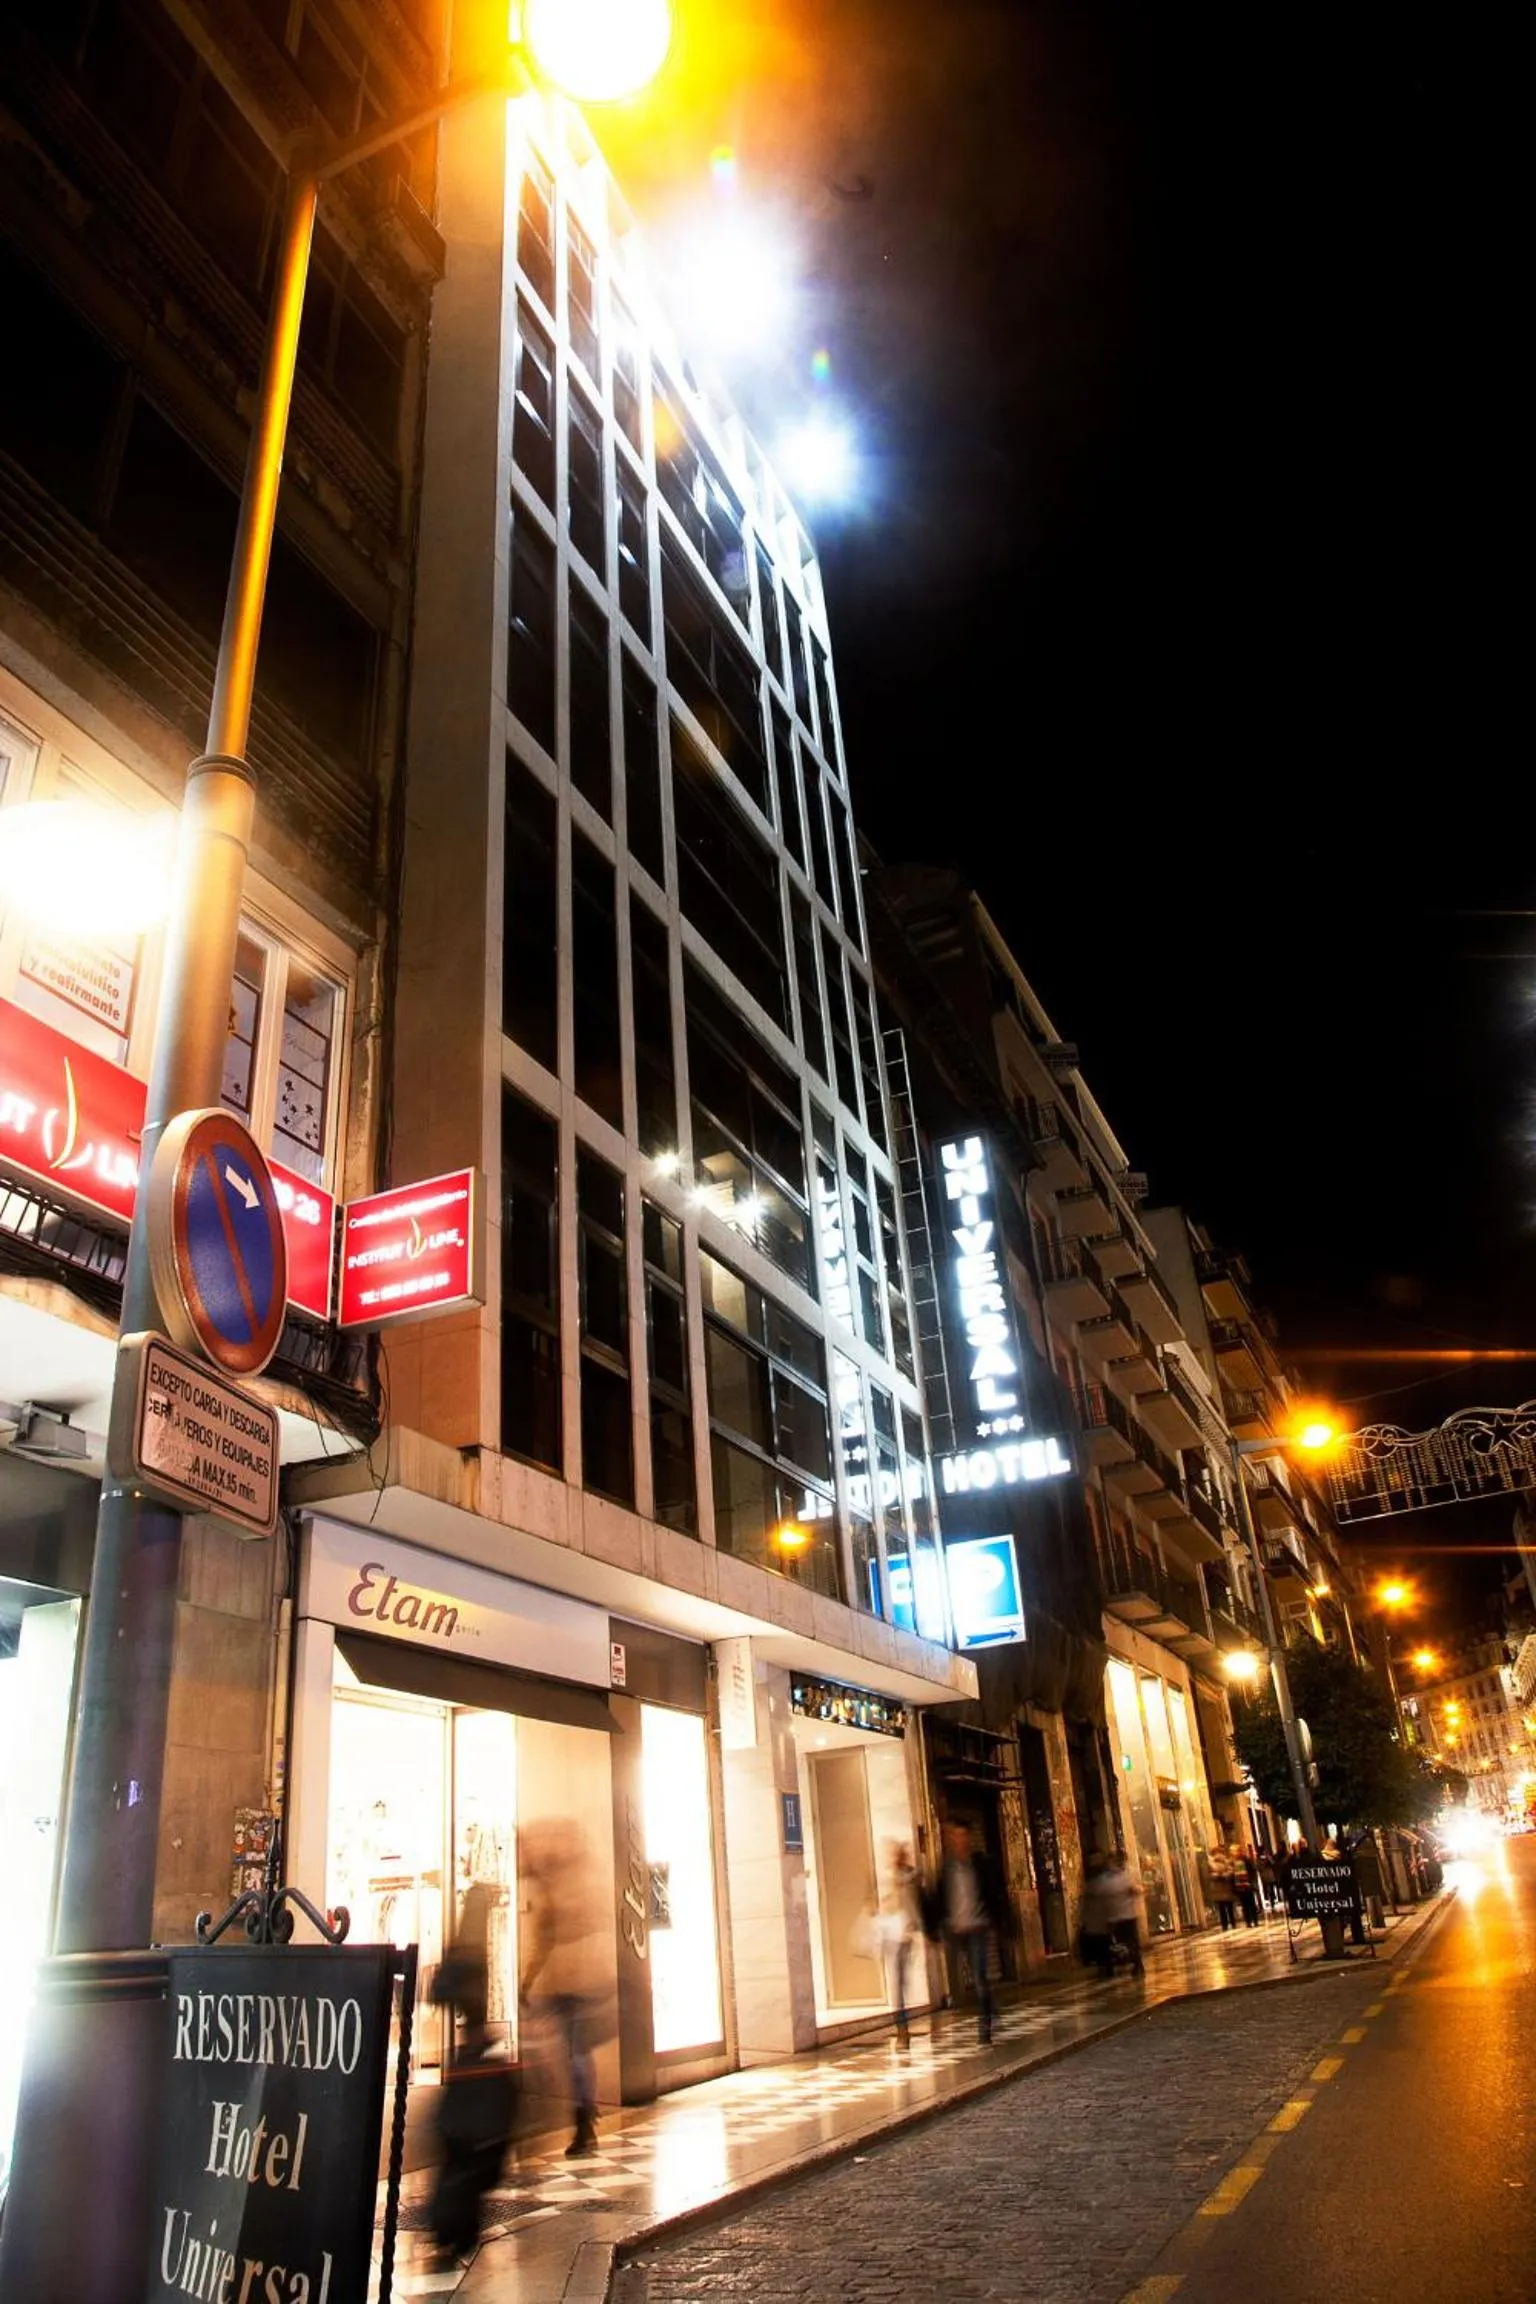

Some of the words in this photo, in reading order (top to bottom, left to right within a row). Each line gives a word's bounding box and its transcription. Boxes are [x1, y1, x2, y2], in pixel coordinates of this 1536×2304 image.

[43, 964, 121, 1021] reafirmante
[940, 1135, 1018, 1412] UNIVERSAL
[150, 1363, 193, 1401] EXCEPTO
[193, 1387, 221, 1421] CARGA
[221, 1406, 229, 1424] Y
[214, 1432, 223, 1451] Y
[222, 1436, 269, 1478] EQUIPAJES
[941, 1437, 1072, 1495] HOTEL
[347, 1562, 459, 1638] Etam
[1291, 1865, 1352, 1880] RESERVADO
[1304, 1881, 1340, 1894] Hotel
[1296, 1896, 1354, 1910] Universal
[173, 1993, 363, 2075] RESERVADO
[204, 2099, 309, 2192] Hotel
